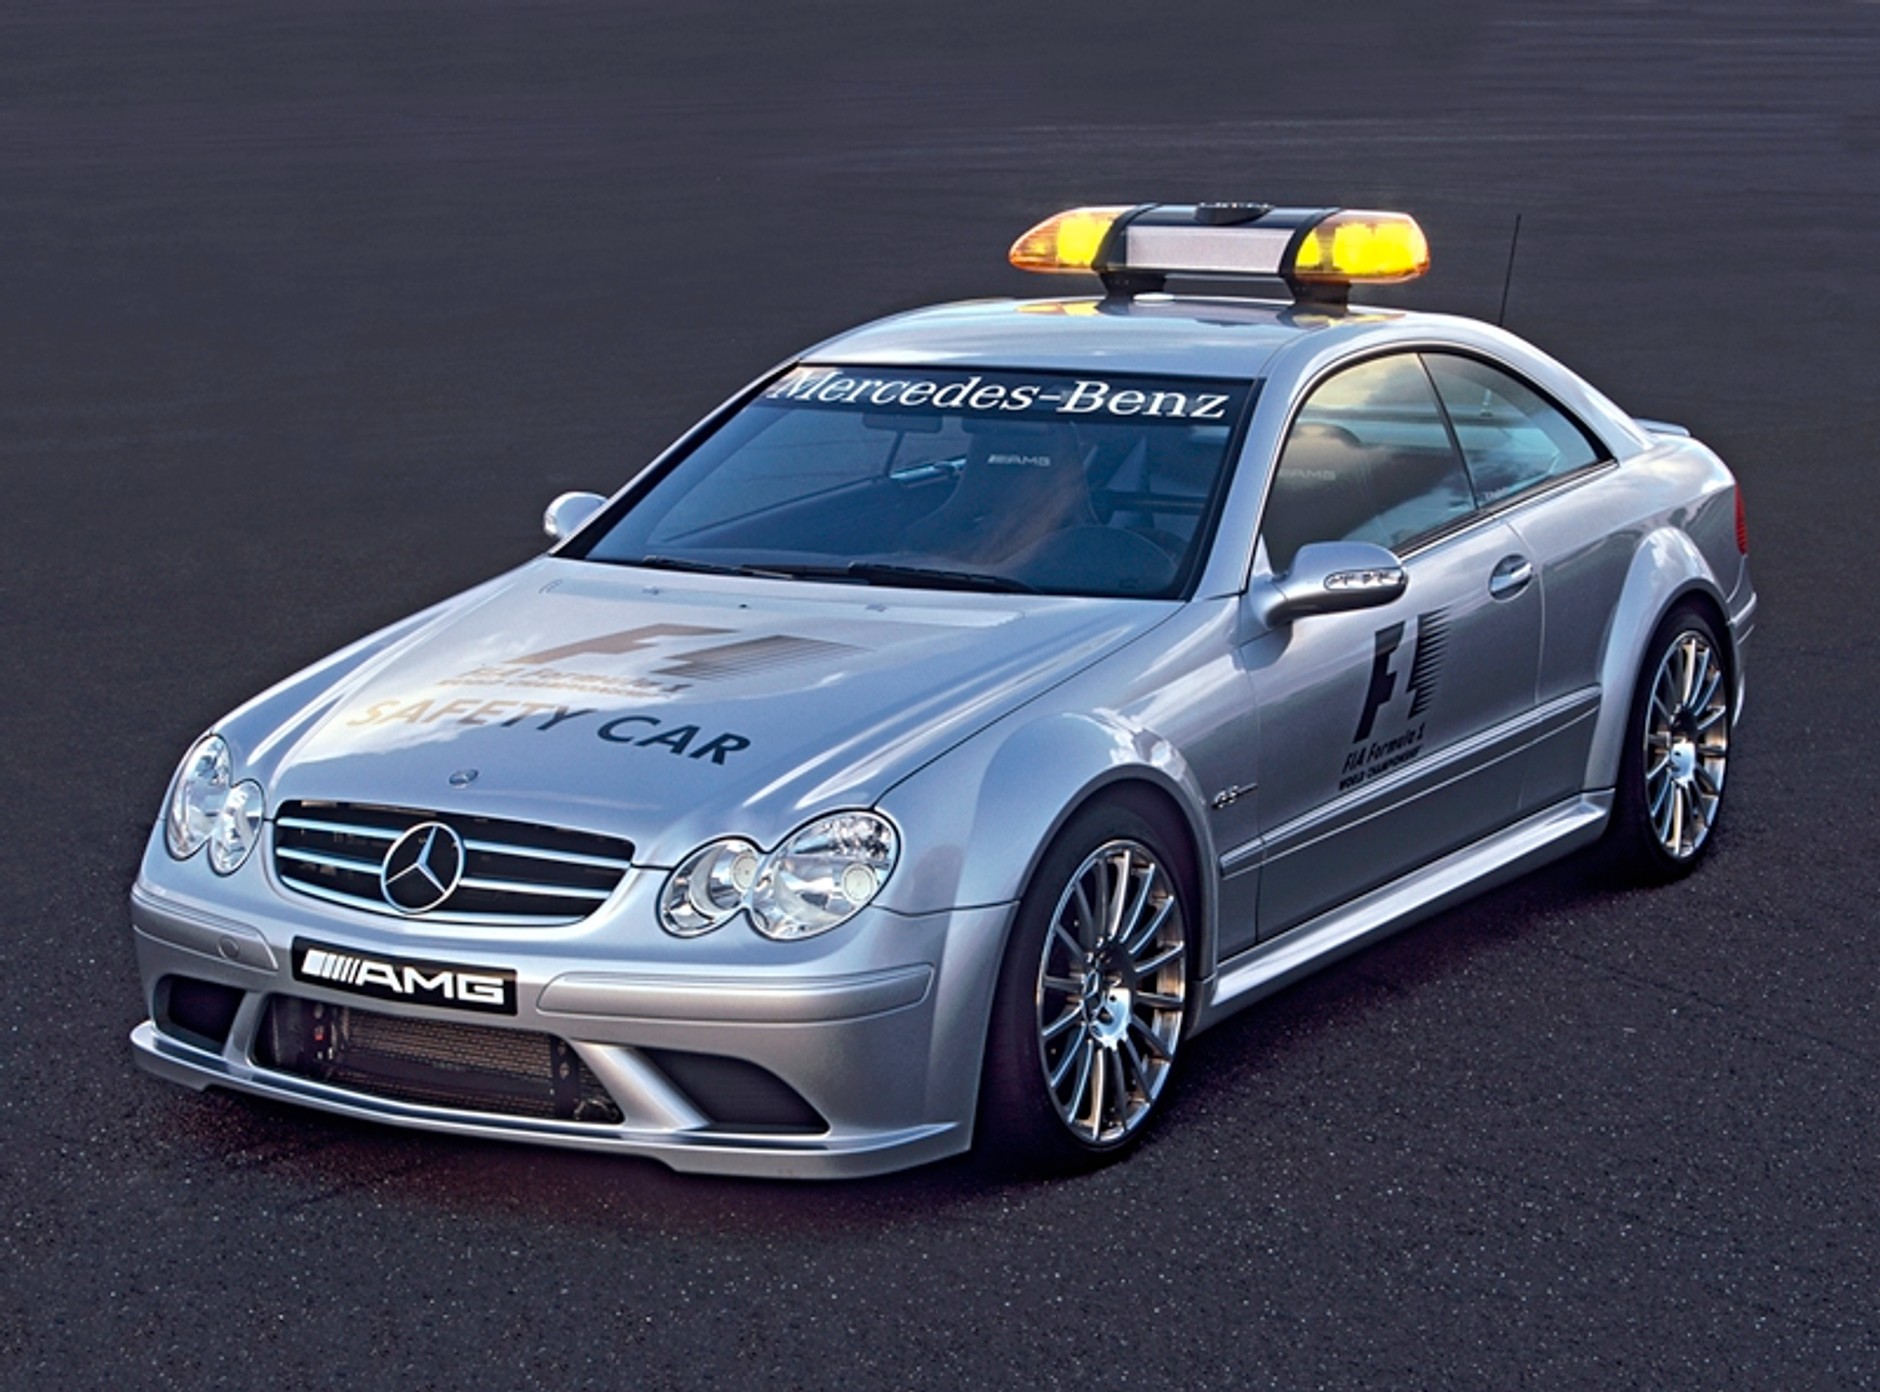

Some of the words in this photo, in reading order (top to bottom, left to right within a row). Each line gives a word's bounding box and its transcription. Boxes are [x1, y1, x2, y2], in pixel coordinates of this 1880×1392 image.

[767, 369, 1230, 419] Mercedes-Benz
[1352, 605, 1451, 744] F1
[346, 698, 597, 731] SAFETY
[597, 714, 752, 766] CAR
[356, 958, 505, 1005] AMG
